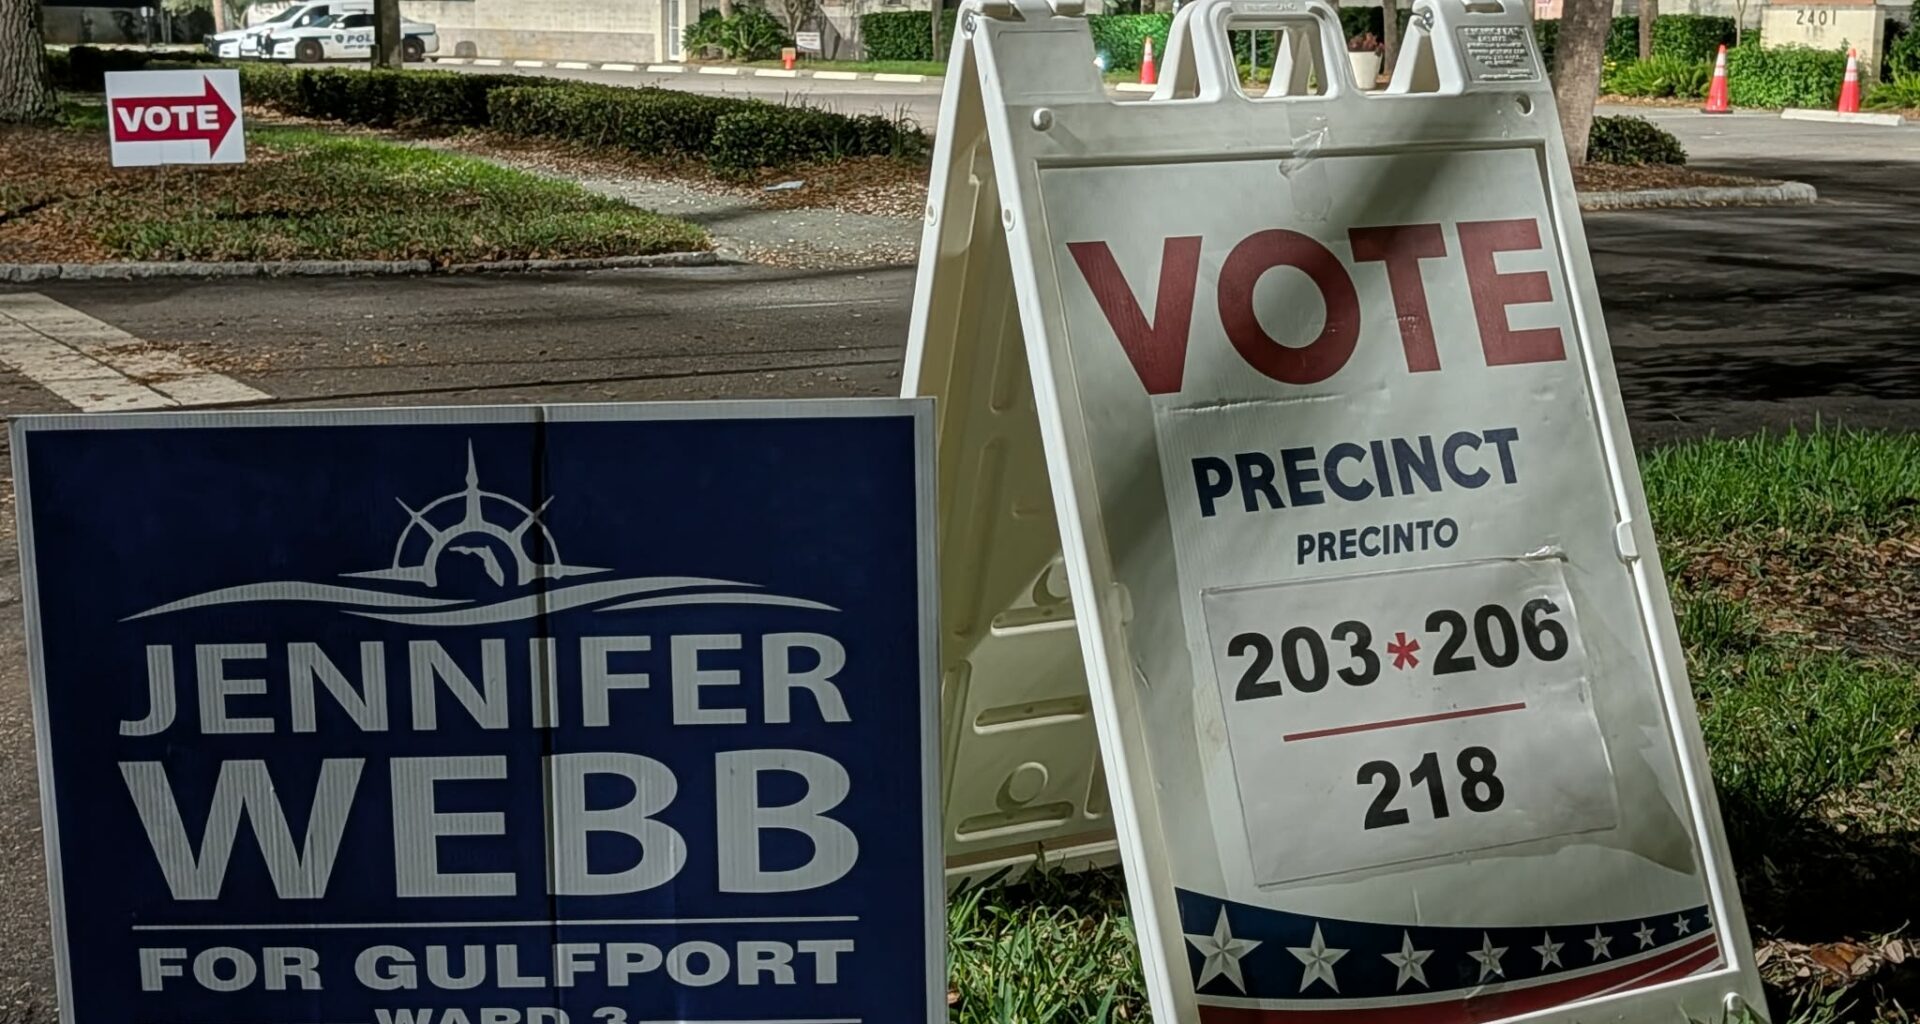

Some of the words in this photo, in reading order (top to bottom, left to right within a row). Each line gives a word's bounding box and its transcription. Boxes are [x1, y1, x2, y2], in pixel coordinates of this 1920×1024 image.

[1796, 9, 1836, 26] 2401
[117, 104, 220, 132] VOTE
[1066, 219, 1567, 394] VOTE
[1191, 427, 1520, 518] PRECINCT
[1297, 517, 1459, 565] PRECINTO
[119, 632, 852, 736] JENNIFER
[117, 748, 860, 900] WEBB
[1355, 745, 1506, 831] 218
[139, 945, 322, 992] FOR
[354, 938, 855, 991] GULFPORT
